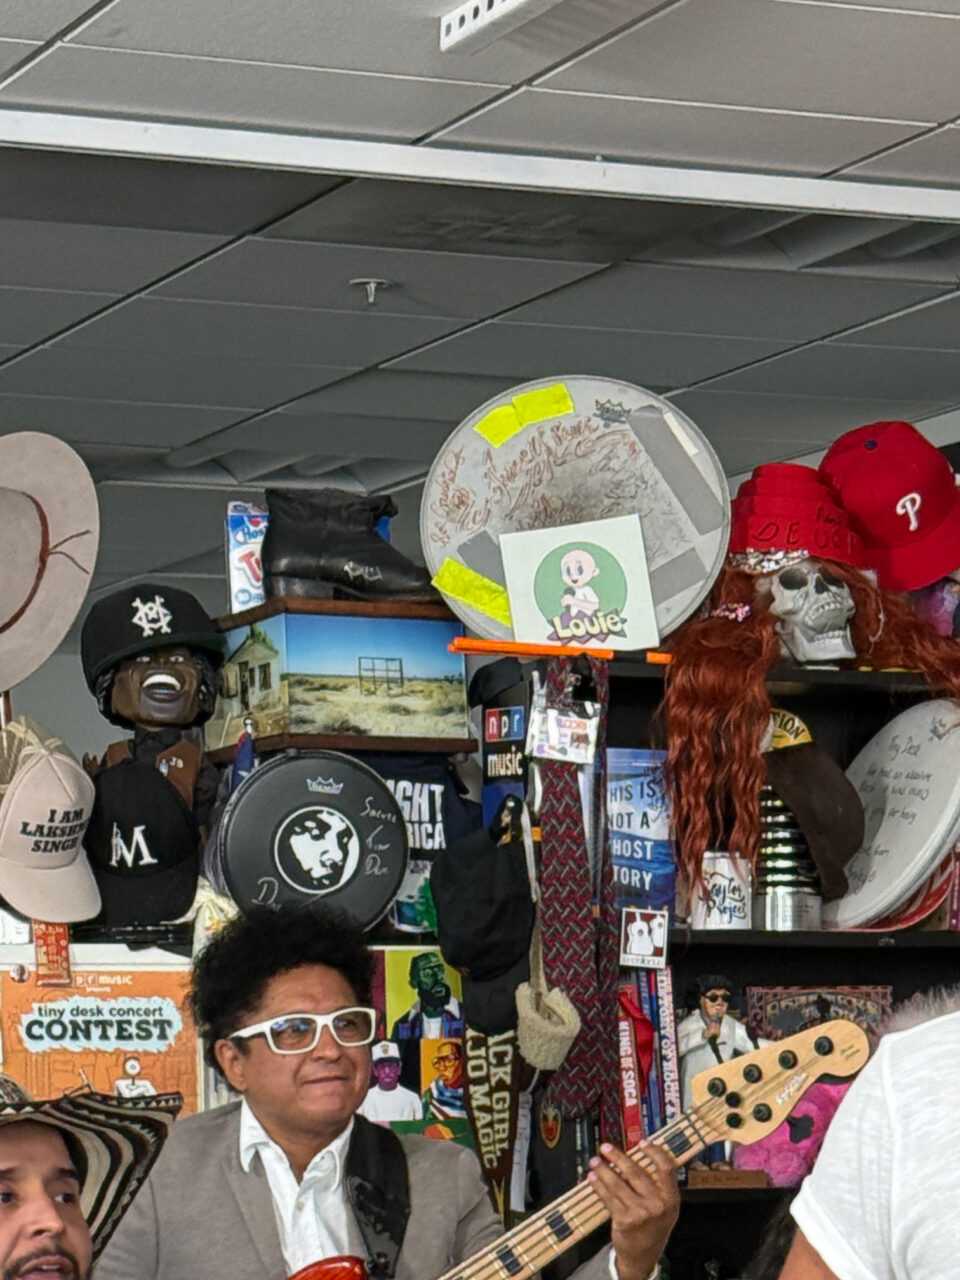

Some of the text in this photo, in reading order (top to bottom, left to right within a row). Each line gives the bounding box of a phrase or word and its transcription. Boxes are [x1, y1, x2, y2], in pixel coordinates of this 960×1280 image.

[896, 492, 922, 531] P
[552, 611, 623, 639] Louie
[489, 714, 522, 738] npr
[487, 745, 523, 778] music
[384, 779, 445, 822] IGHT
[608, 780, 656, 803] HIS IS
[47, 807, 85, 824] I AM
[639, 812, 650, 828] A
[108, 821, 158, 868] M
[612, 840, 654, 860] HOST
[612, 872, 653, 891] TORY
[37, 1004, 164, 1019] tiny desk concert
[25, 1018, 174, 1042] CONTEST
[619, 1020, 632, 1056] KING
[624, 1070, 638, 1107] SOCA
[468, 1083, 499, 1169] MAGIC
[492, 1091, 511, 1157] GIRL
